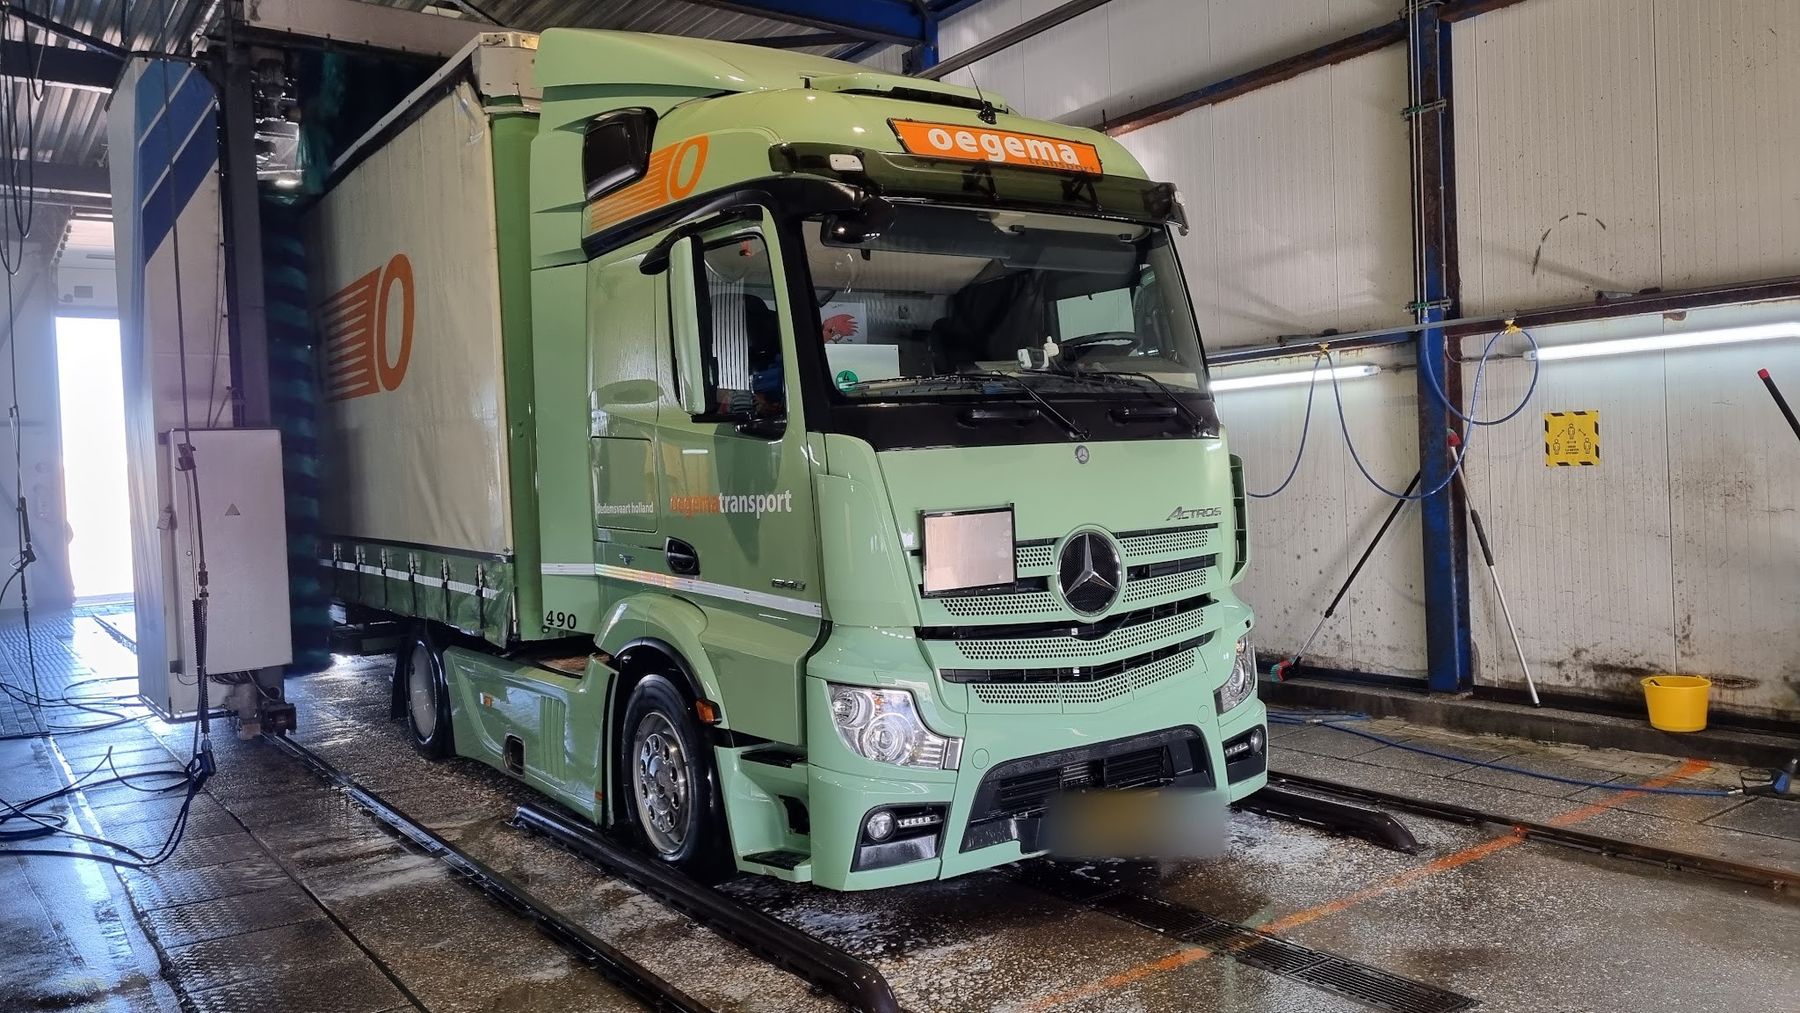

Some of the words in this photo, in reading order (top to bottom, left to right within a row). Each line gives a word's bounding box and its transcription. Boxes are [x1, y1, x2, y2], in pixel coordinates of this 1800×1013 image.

[927, 128, 1080, 165] oegema
[631, 501, 654, 514] holland
[545, 610, 577, 629] 490
